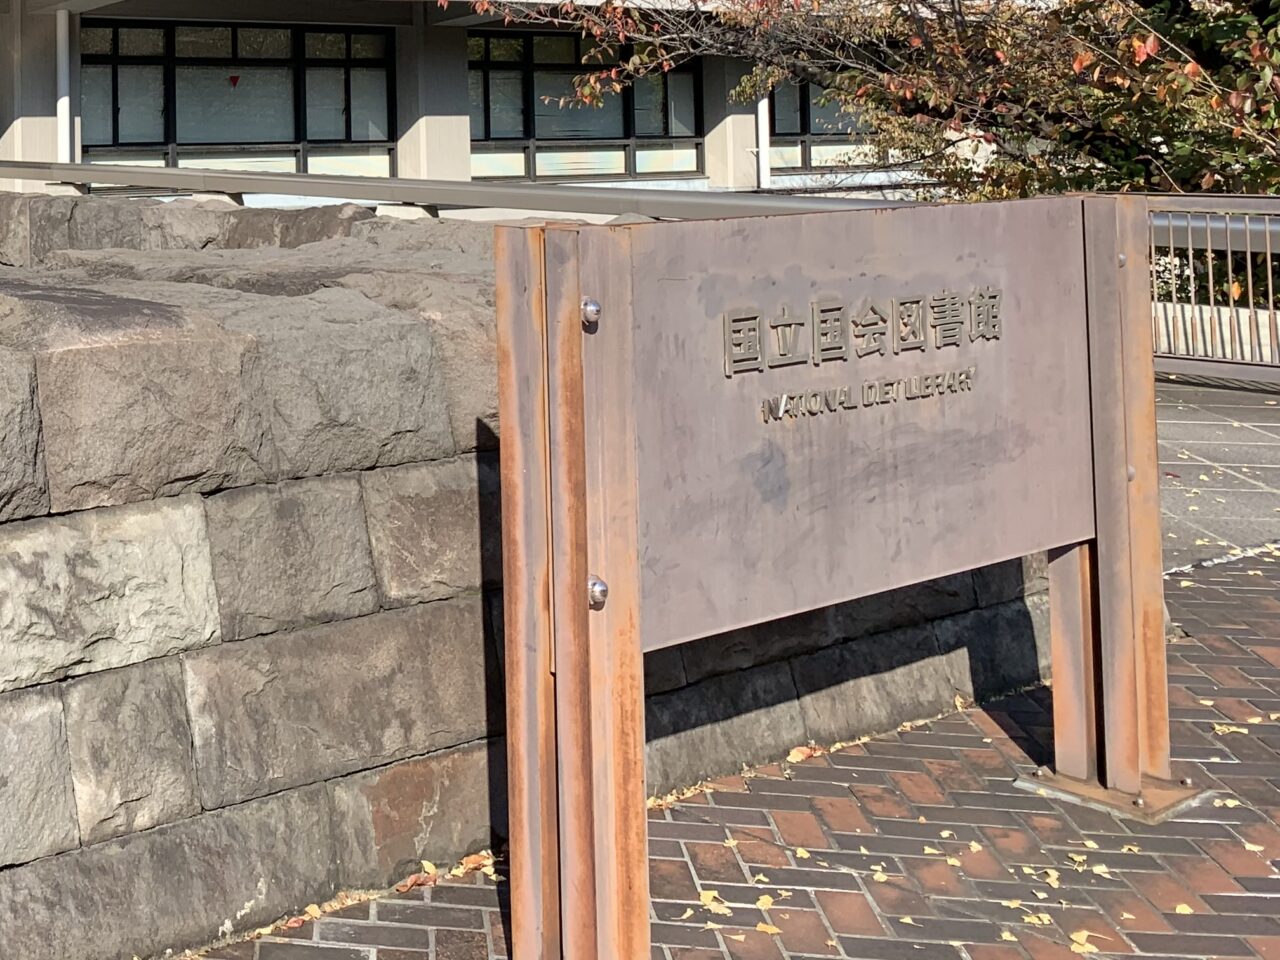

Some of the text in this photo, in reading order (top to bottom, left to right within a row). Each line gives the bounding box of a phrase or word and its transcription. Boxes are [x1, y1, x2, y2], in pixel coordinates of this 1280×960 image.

[722, 286, 1003, 379] 国立国会図書館
[761, 366, 976, 424] NATIONAL DIET LIBRARY
